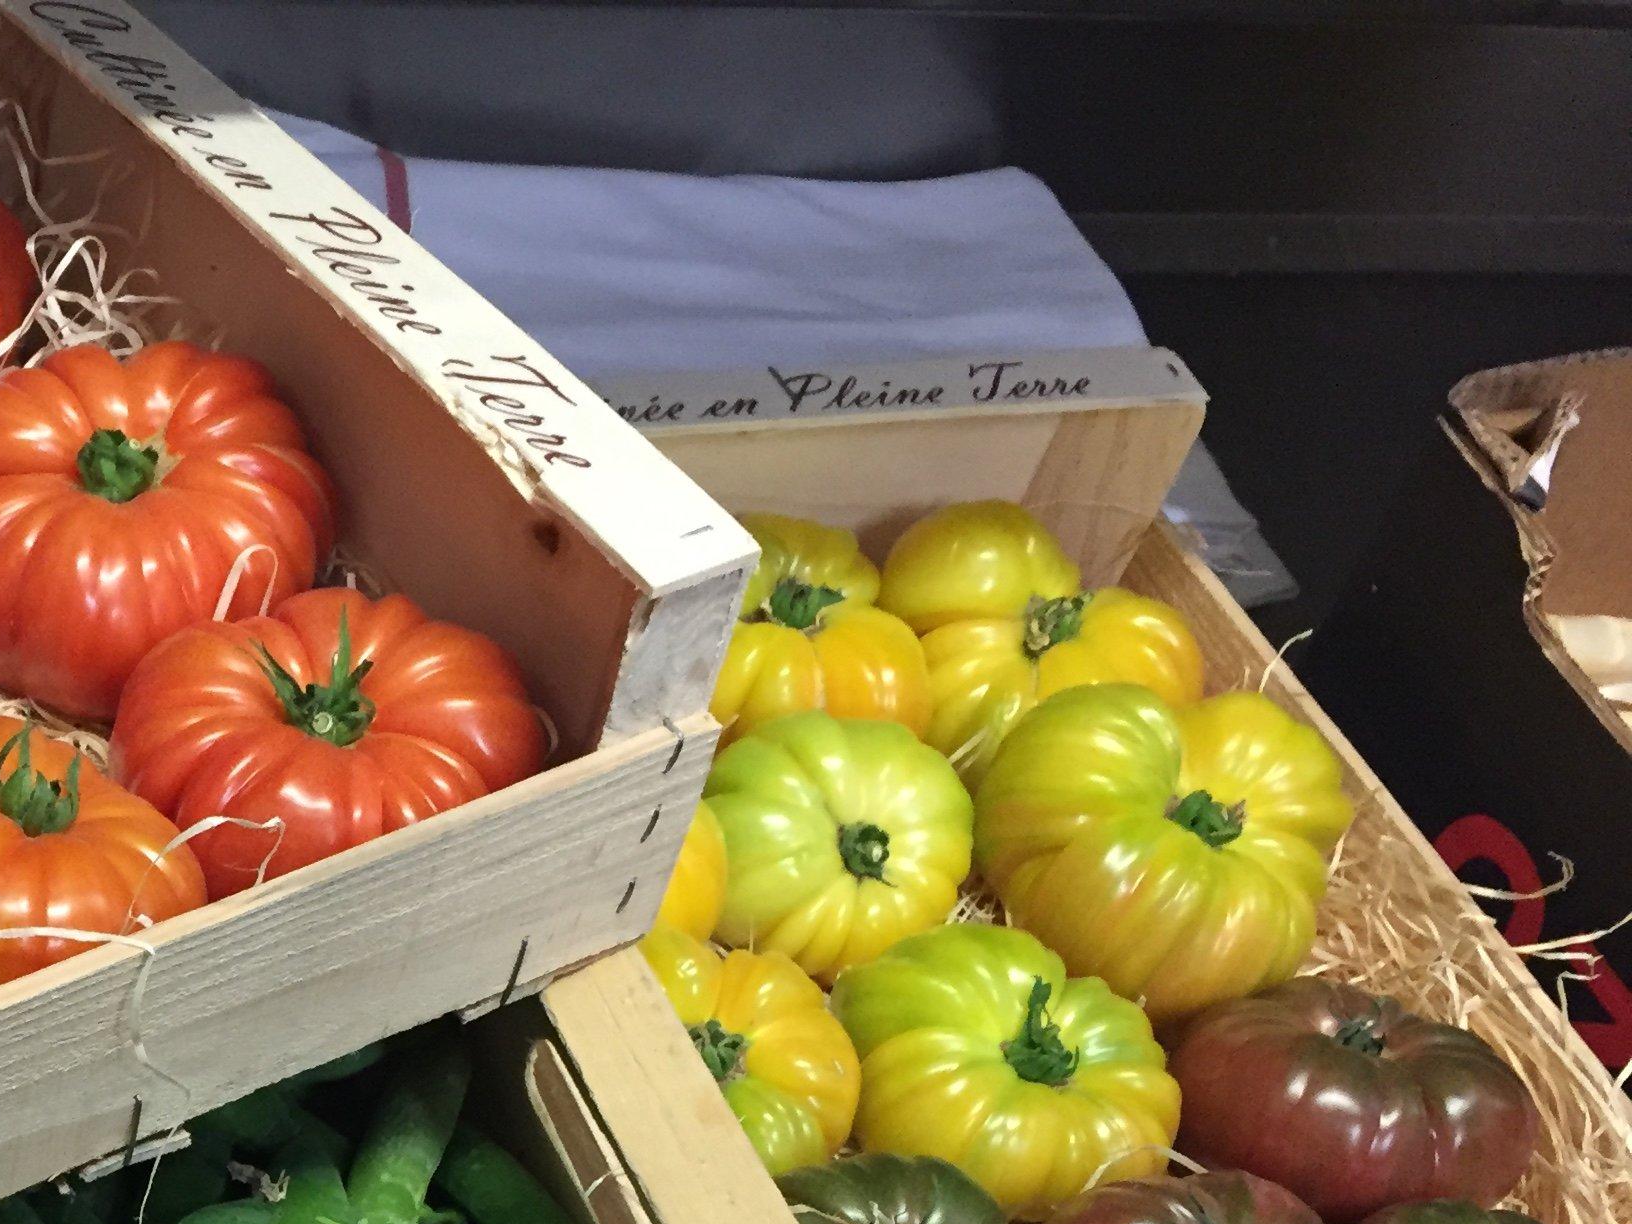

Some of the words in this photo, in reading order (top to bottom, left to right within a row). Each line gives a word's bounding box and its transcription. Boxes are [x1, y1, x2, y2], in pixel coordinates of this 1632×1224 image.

[29, 1, 213, 140] Cultivée
[196, 147, 273, 191] en
[270, 206, 441, 336] Pleine
[441, 355, 591, 470] Terre
[699, 397, 759, 419] en
[768, 366, 943, 413] Pleine
[968, 361, 1090, 402] Terre
